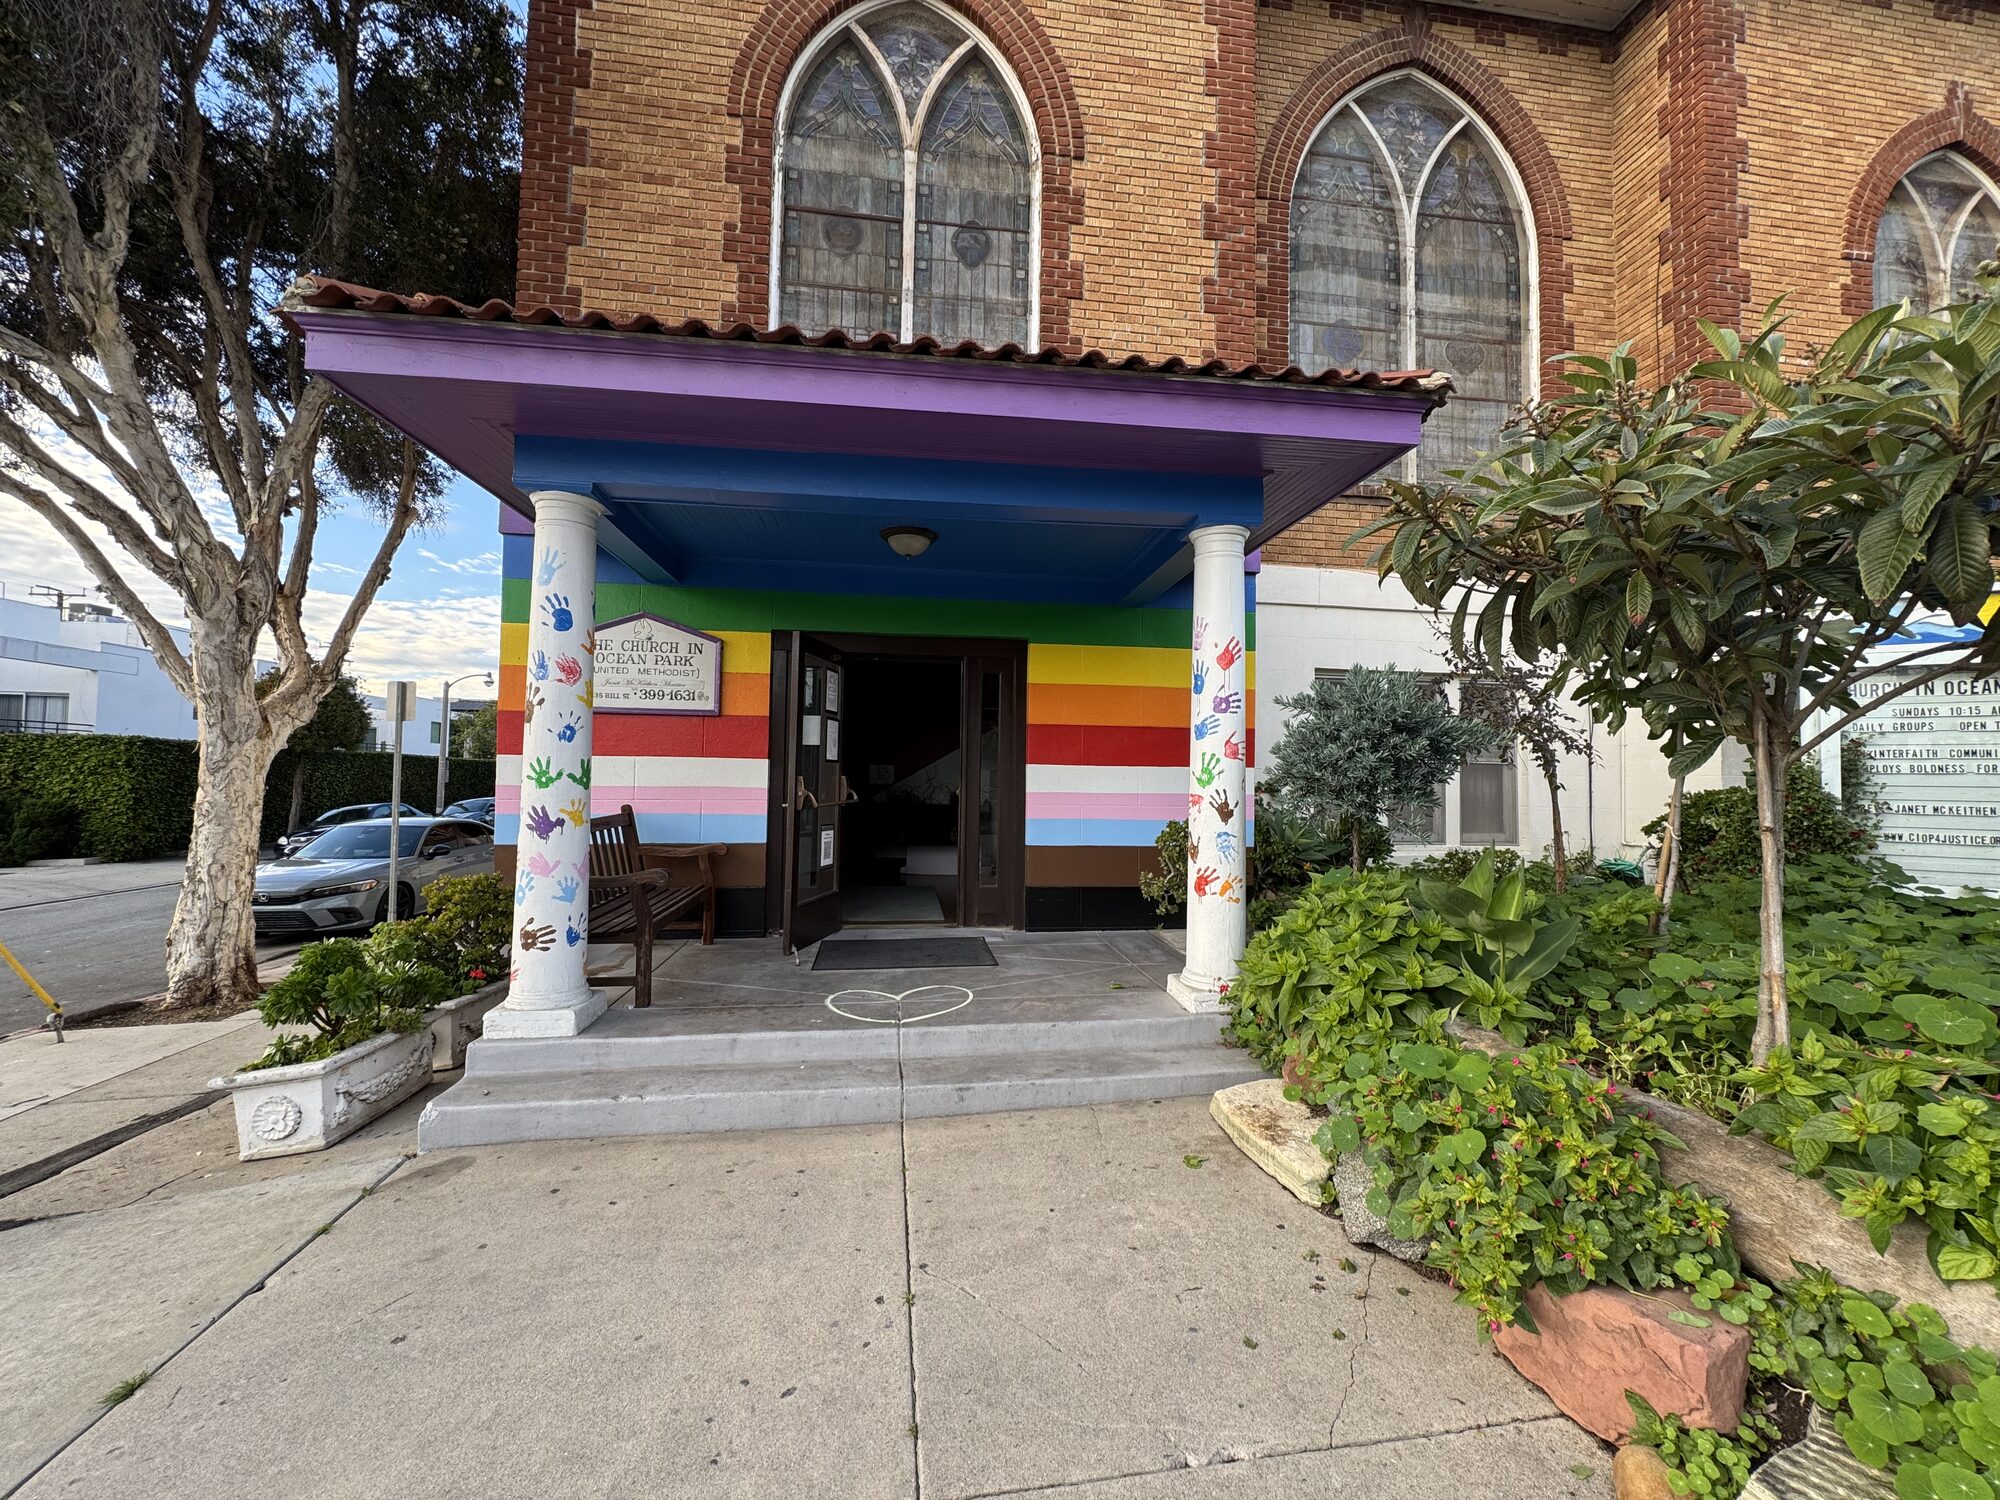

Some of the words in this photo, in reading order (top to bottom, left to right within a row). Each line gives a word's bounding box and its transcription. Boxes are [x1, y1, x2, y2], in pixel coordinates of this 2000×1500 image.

[594, 639, 613, 651] HE
[621, 639, 679, 654] CHURCH
[688, 642, 704, 655] IN
[595, 652, 647, 665] OCEAN
[654, 654, 695, 667] PARK
[593, 666, 629, 675] UNITED
[637, 667, 700, 680] METHODIST)
[639, 688, 696, 701] 399-1631
[1848, 682, 1903, 698] HURC
[1892, 707, 1940, 717] SUNDAYS
[1950, 706, 1981, 716] 10:15
[1852, 722, 1884, 732] DAILY
[1892, 721, 1934, 731] GROUPS
[1959, 721, 1987, 731] OPEN
[1874, 748, 1938, 758] INTERFAITH
[1866, 764, 1902, 774] PLOYS
[1909, 764, 1966, 774] BOLDNESS
[1977, 764, 1998, 773] FOR
[1894, 804, 1927, 814] JANET
